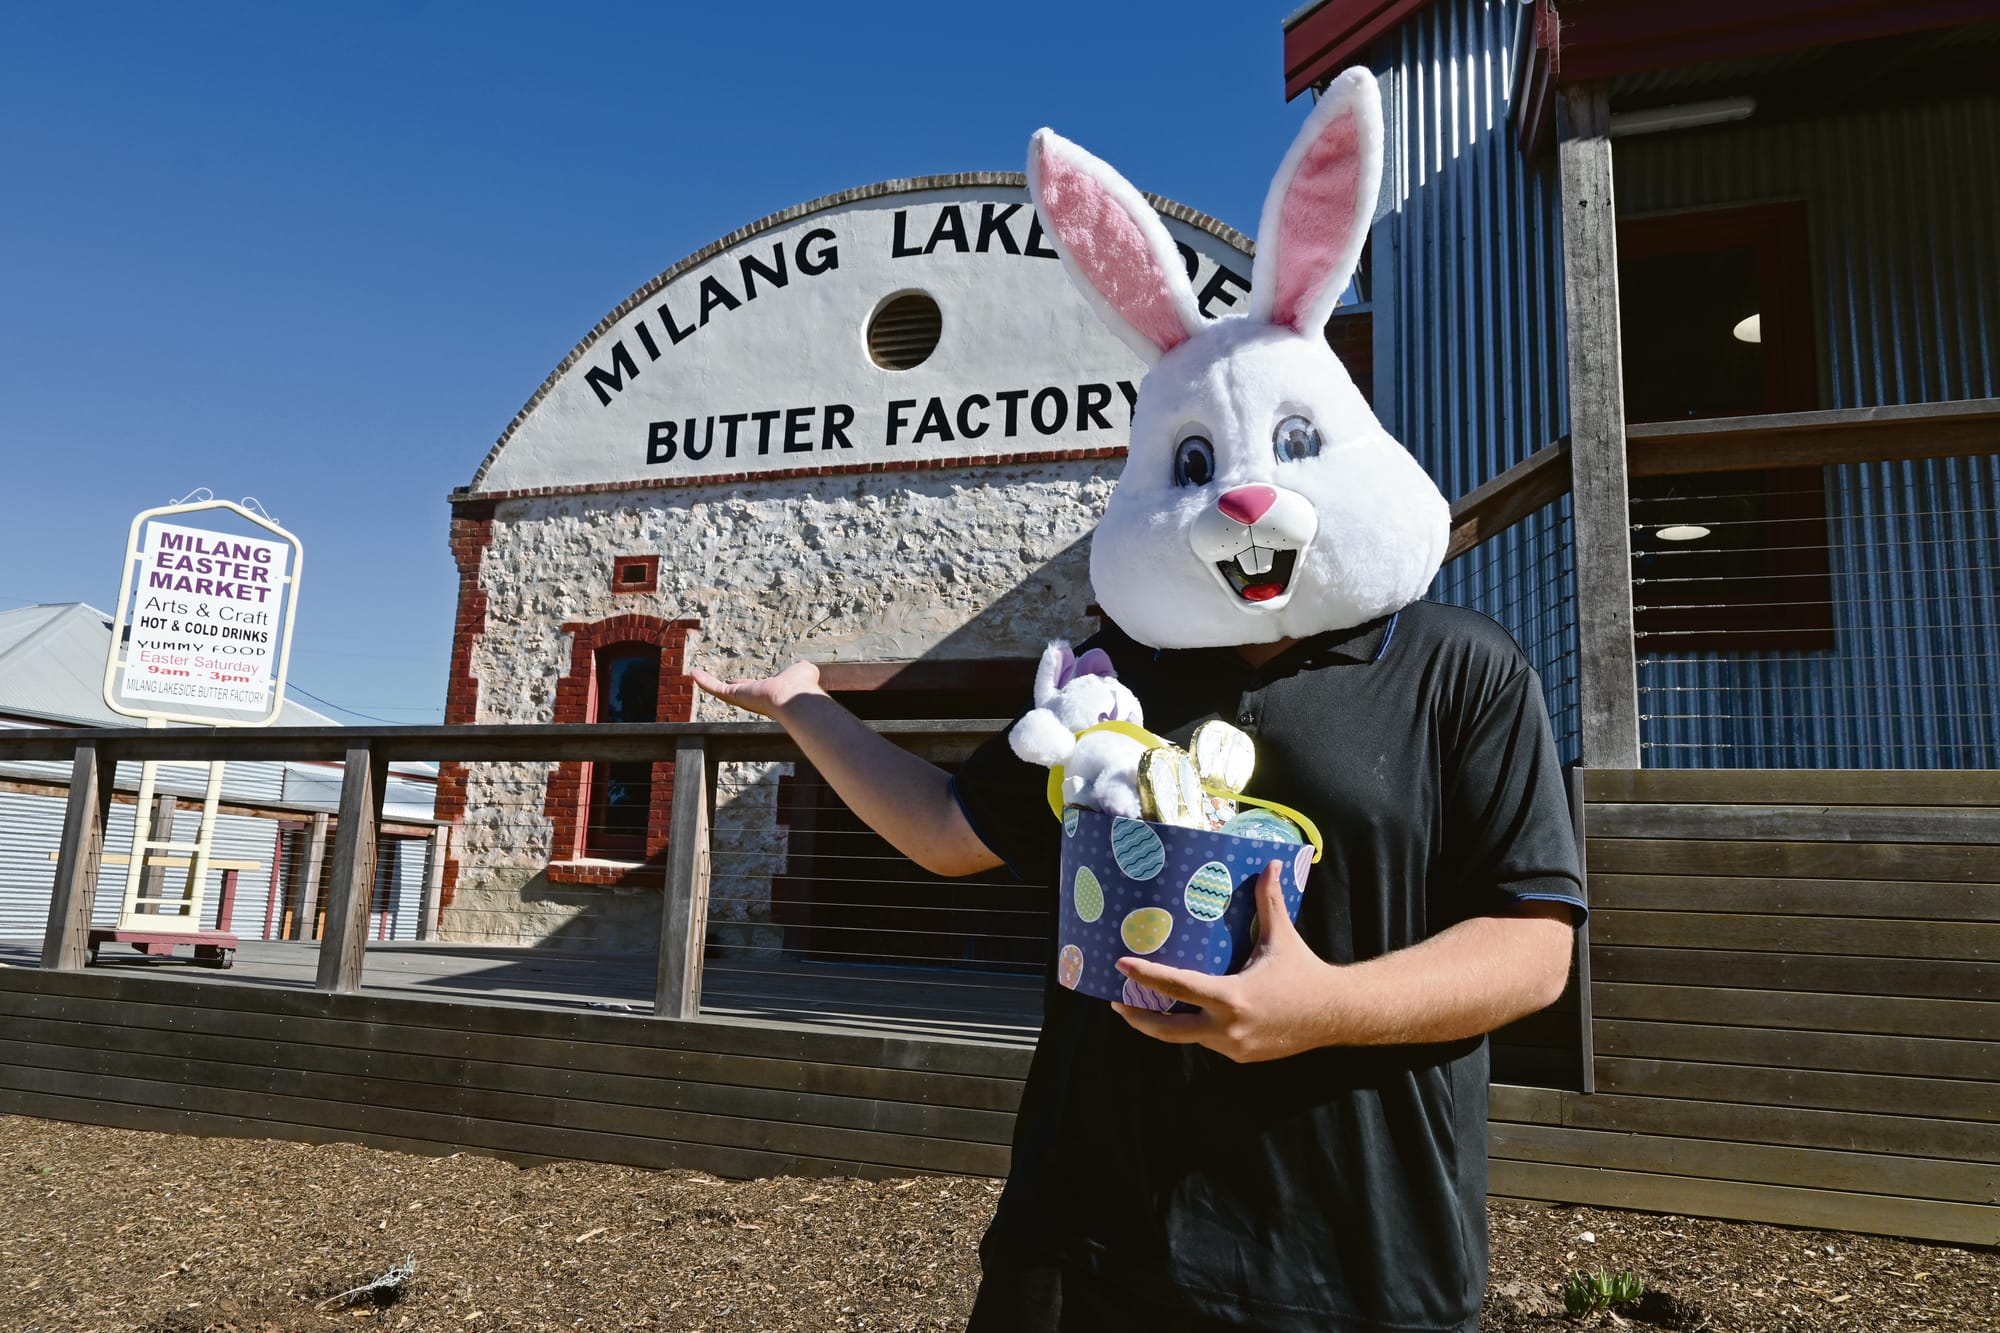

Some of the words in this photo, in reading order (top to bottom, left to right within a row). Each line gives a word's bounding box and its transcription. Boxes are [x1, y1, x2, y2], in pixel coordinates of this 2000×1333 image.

[584, 228, 839, 407] MILANG
[646, 404, 855, 465] BUTTER
[160, 532, 272, 564] MILANG
[156, 551, 269, 583] EASTER
[149, 571, 272, 603] MARKET
[145, 596, 188, 615] Arts
[196, 603, 210, 618] &
[219, 606, 268, 626] Craft
[140, 616, 168, 630] HOT
[171, 620, 180, 632] &
[185, 621, 218, 637] COLD
[222, 627, 268, 643] DRINKS
[137, 640, 204, 652] YUMMY
[212, 645, 266, 656] FOOD
[140, 650, 190, 667] Easter
[194, 656, 259, 676] Saturday
[147, 665, 190, 677] 9am
[210, 671, 250, 683] 3pm
[126, 678, 157, 693] MILANG
[158, 681, 197, 698] LAKESIDE
[198, 685, 229, 701] BUTTER
[230, 688, 265, 704] FACTORY
